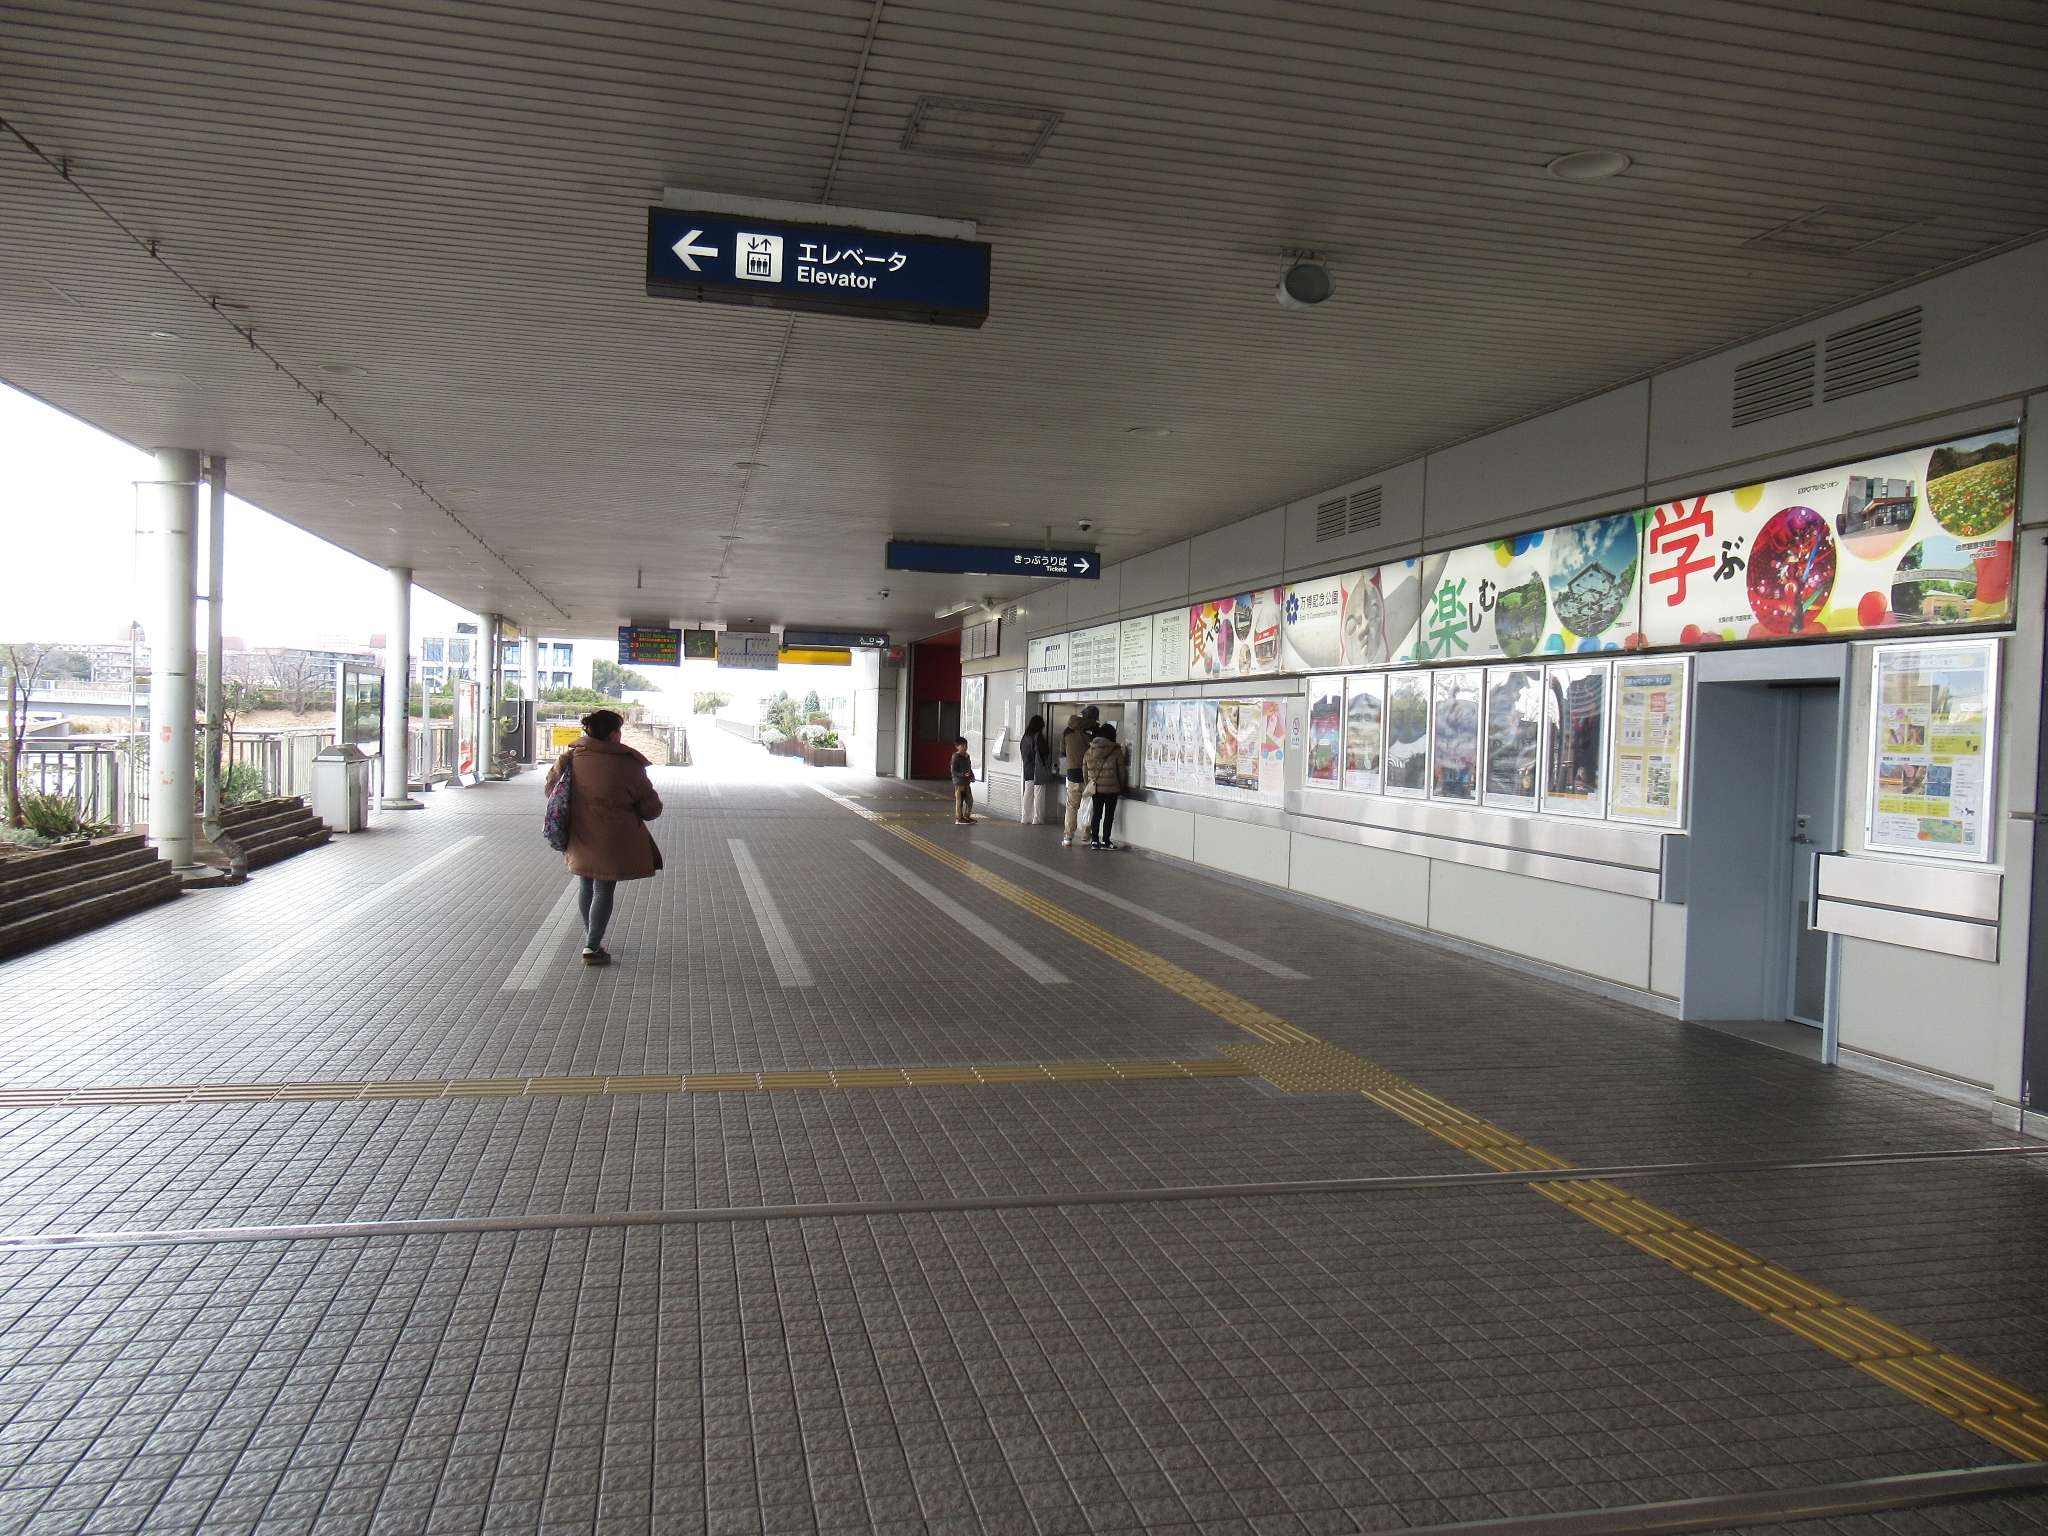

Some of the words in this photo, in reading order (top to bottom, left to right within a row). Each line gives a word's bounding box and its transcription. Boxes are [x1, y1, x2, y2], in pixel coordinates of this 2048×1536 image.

[797, 242, 907, 272] エレベータ
[797, 266, 877, 290] Elevator
[1014, 554, 1067, 567] きっぷうりば
[1649, 495, 1746, 607] 学ぶ
[1046, 565, 1067, 573] Tickets
[1428, 577, 1496, 657] 楽しむ
